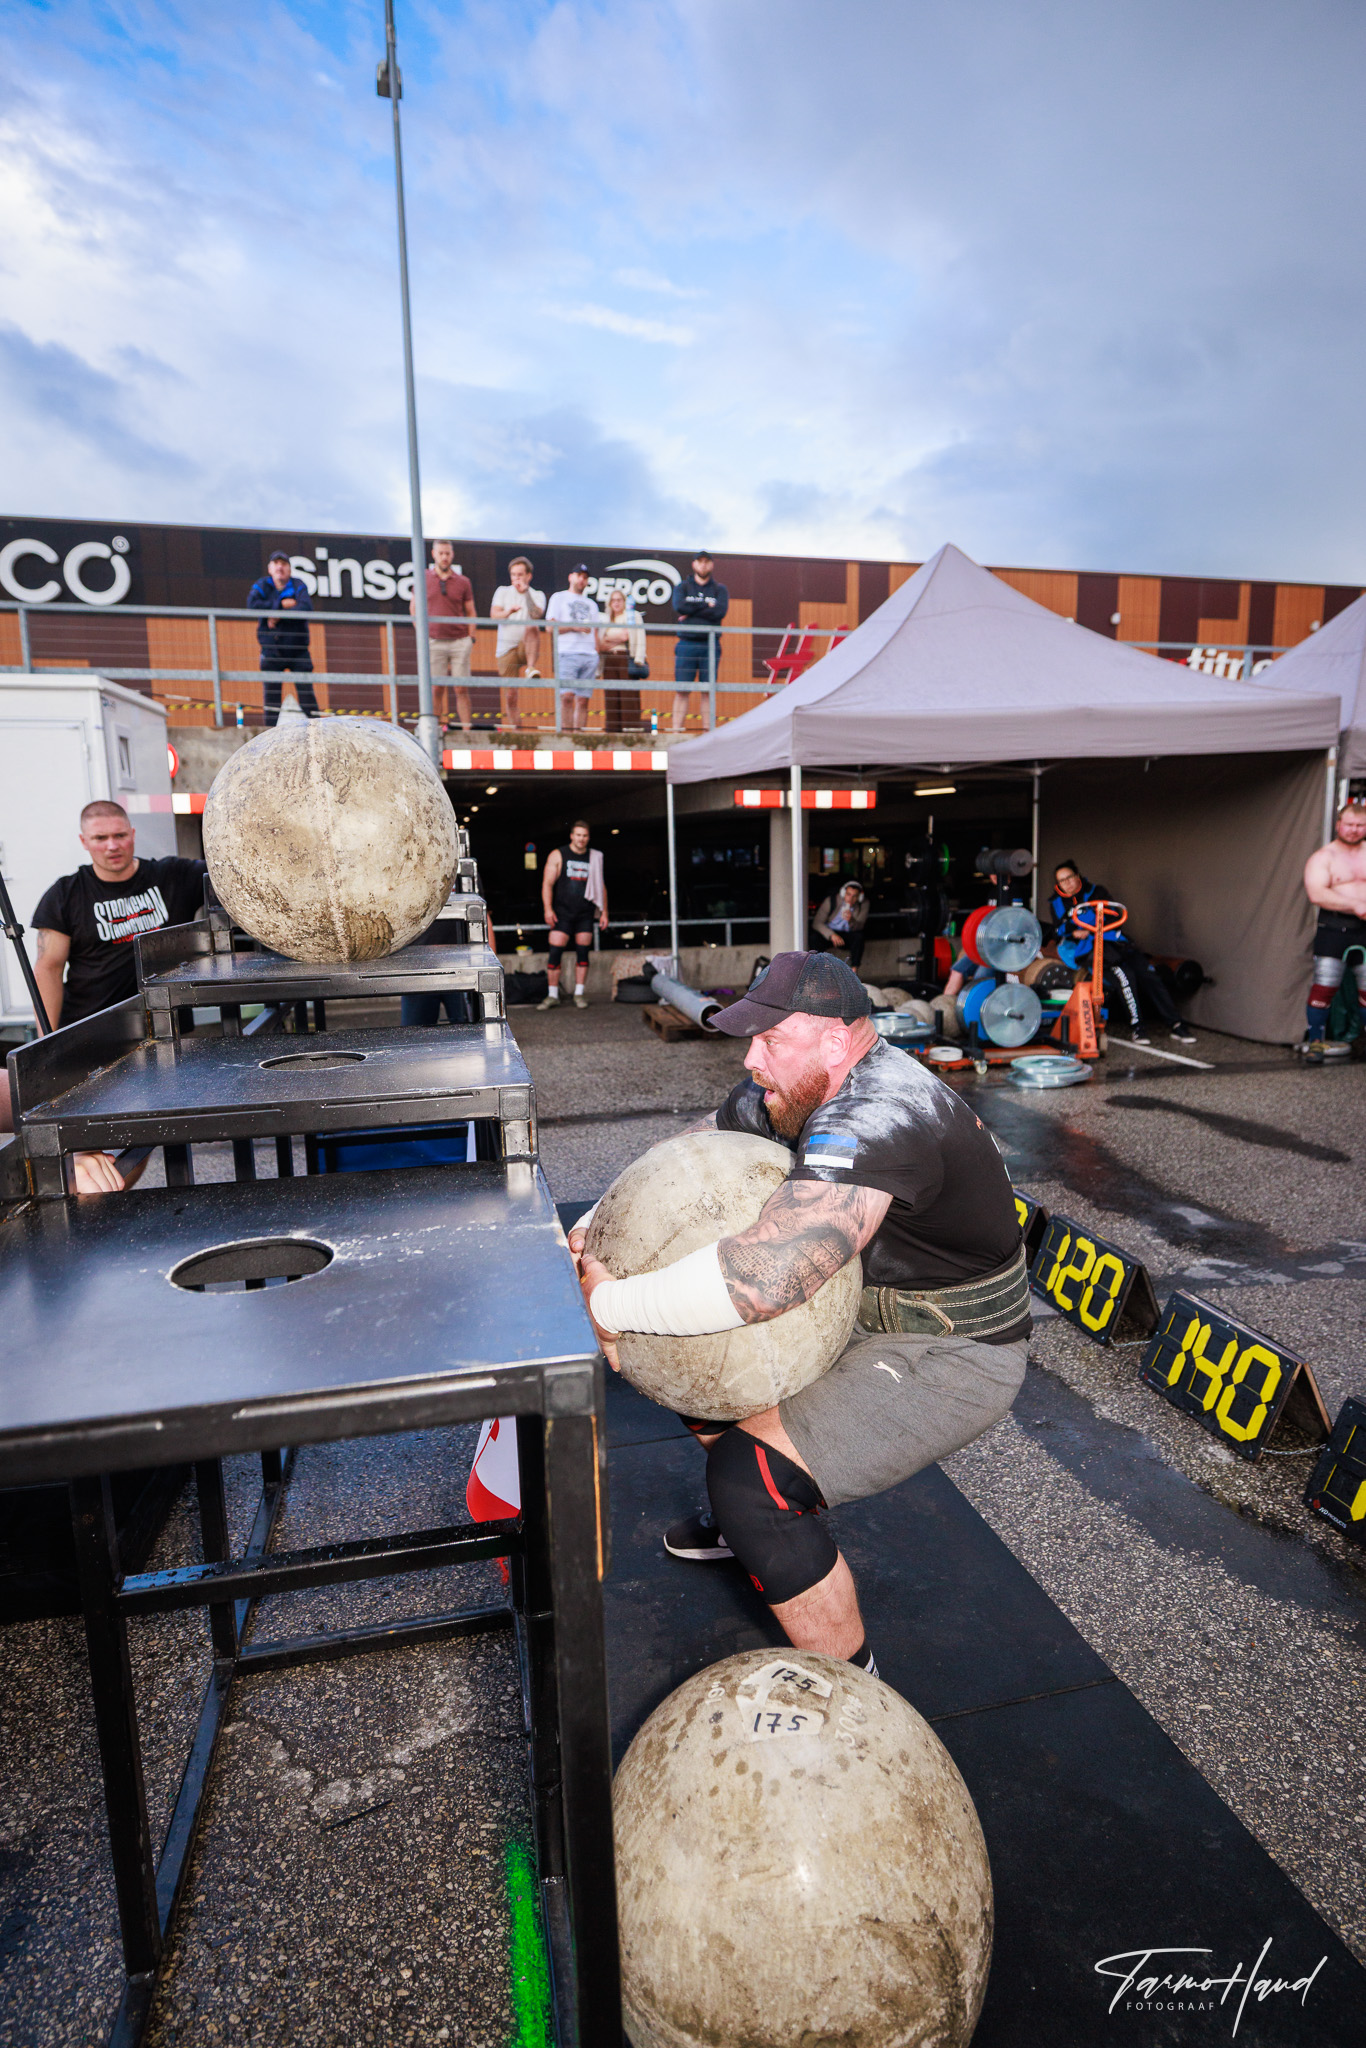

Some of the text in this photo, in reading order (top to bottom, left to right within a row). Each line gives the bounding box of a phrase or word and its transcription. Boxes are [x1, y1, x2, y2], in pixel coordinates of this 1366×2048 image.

[1046, 1233, 1125, 1332] 120
[1167, 1317, 1282, 1442] 140
[771, 1667, 817, 1690] 175
[753, 1712, 808, 1734] 175
